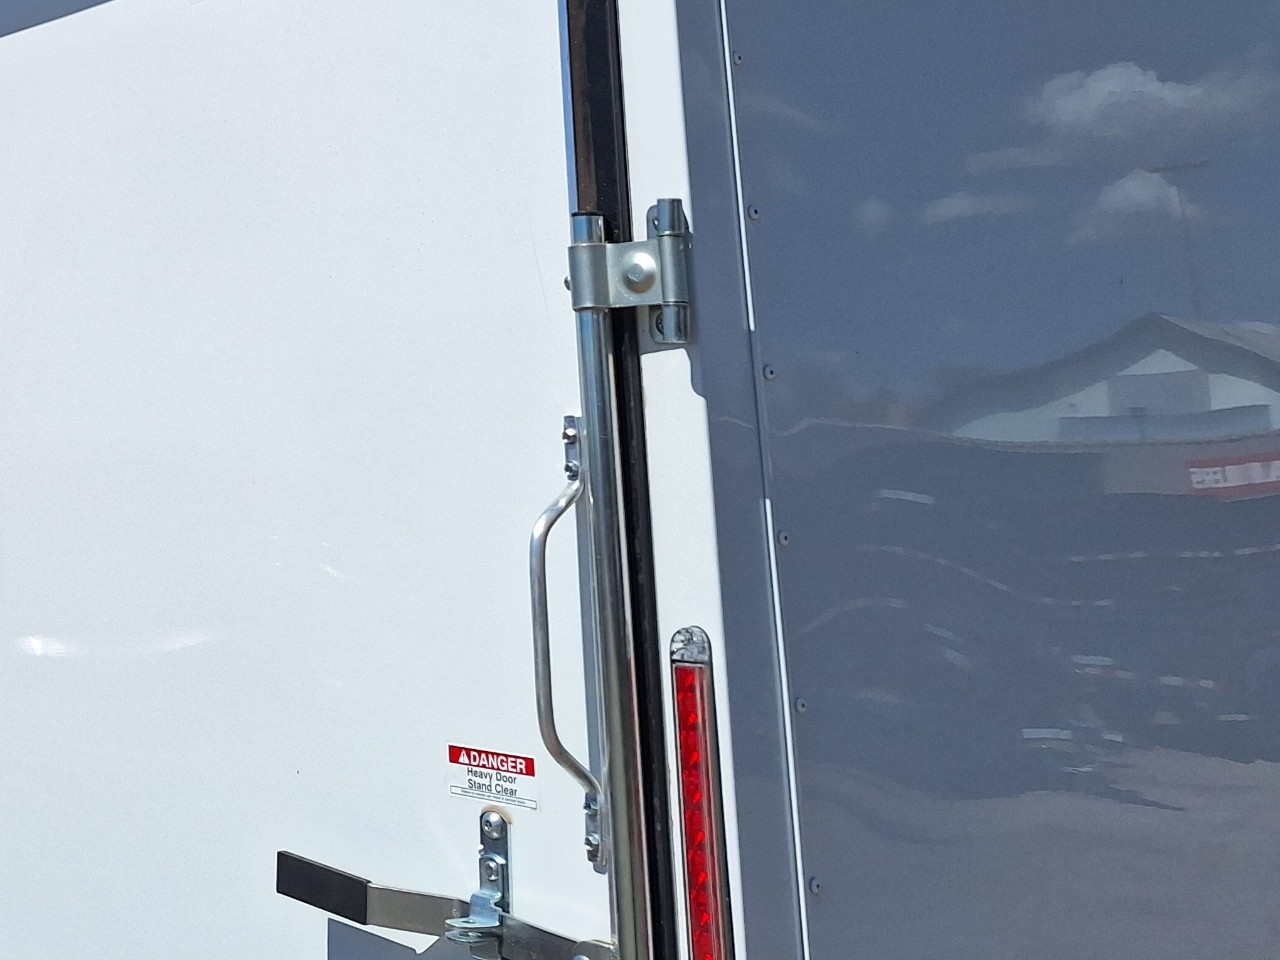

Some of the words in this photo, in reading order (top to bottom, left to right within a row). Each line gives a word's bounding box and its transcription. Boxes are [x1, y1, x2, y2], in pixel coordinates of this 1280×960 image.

[470, 751, 526, 773] DANGER
[467, 767, 493, 784] Heavy
[495, 772, 517, 784] Door
[468, 779, 492, 791] Stand
[495, 784, 517, 796] Clear
